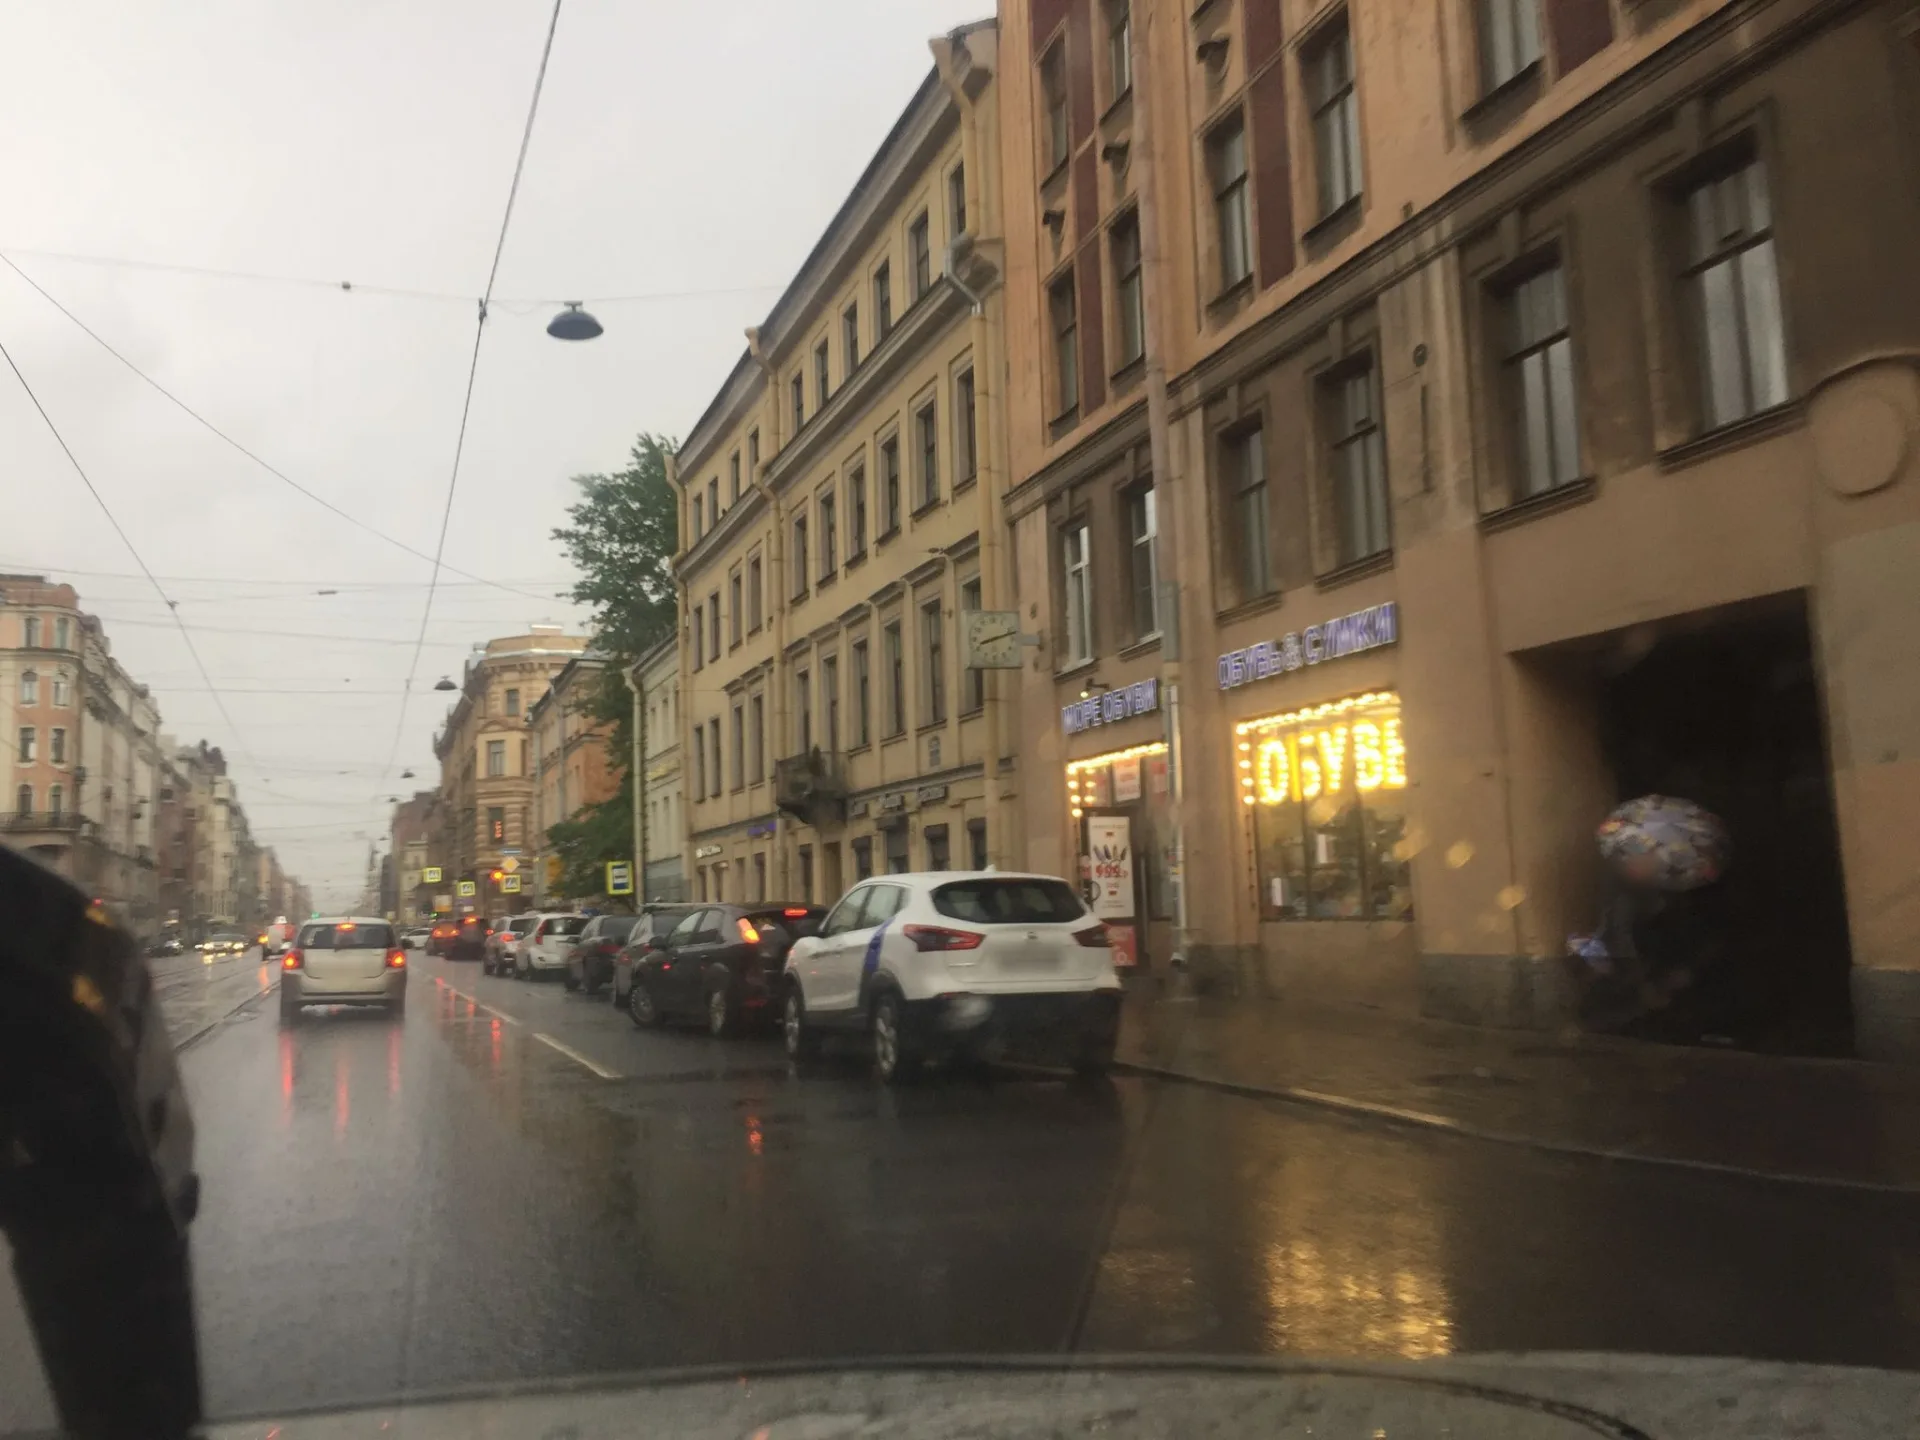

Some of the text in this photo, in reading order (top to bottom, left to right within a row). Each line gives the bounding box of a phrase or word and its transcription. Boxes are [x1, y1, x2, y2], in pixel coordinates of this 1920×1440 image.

[1218, 640, 1283, 690] ОБУВЬ
[1303, 601, 1398, 665] СУМКИ
[1062, 678, 1157, 736] МОРЕ ОБУВИ
